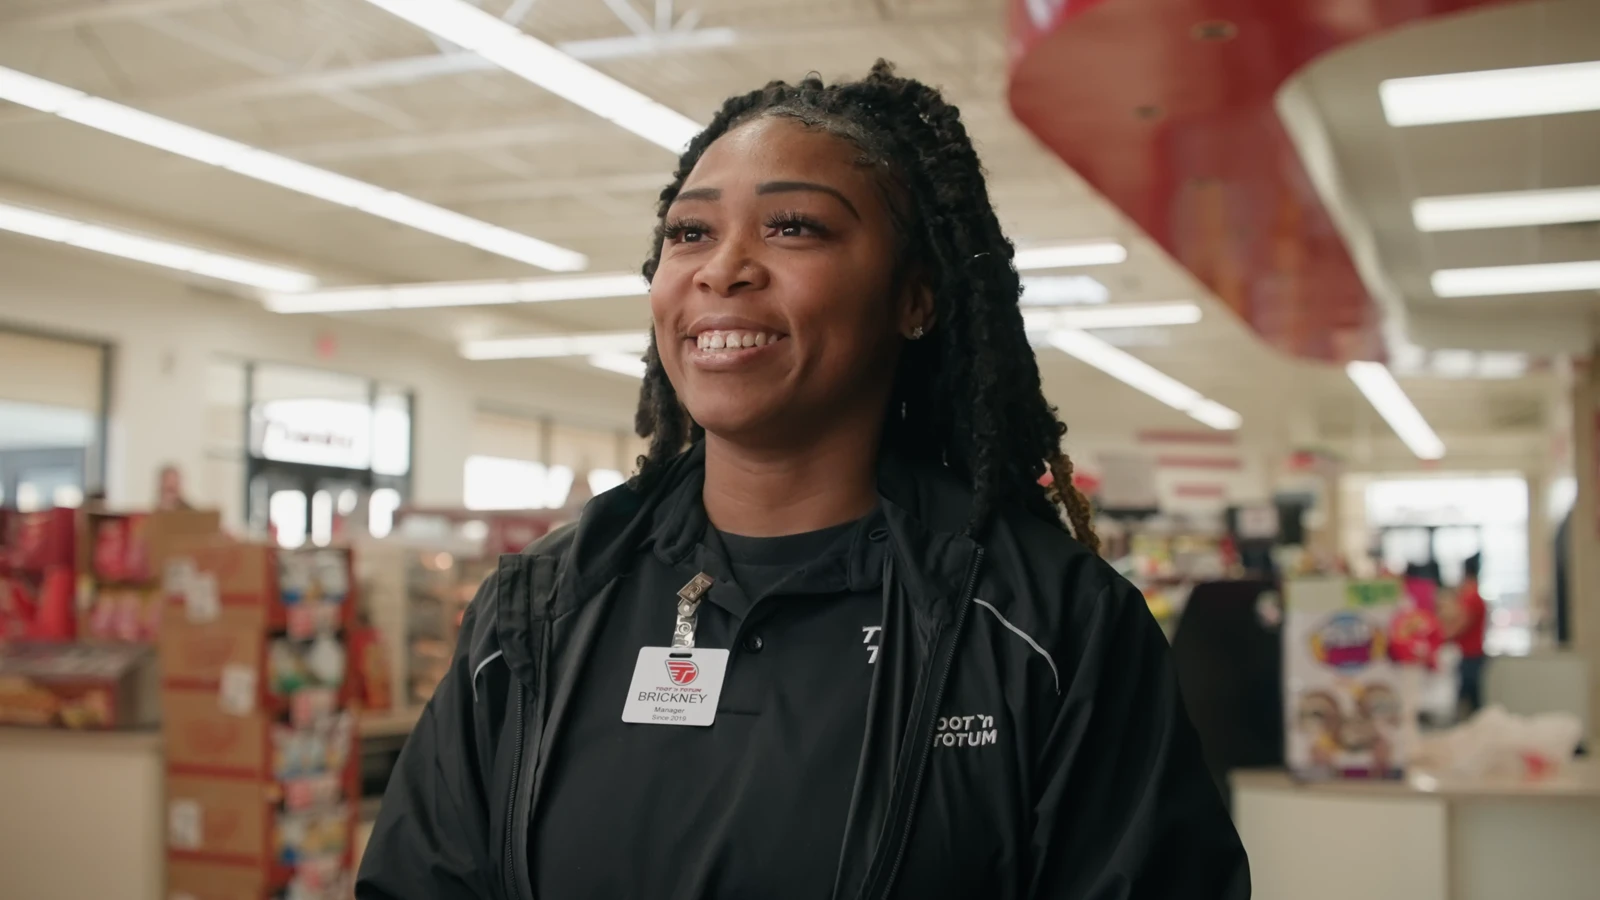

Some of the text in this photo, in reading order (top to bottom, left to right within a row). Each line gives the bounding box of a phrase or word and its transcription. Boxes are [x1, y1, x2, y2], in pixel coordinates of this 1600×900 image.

[638, 691, 707, 703] BRICKNEY
[654, 706, 685, 714] Manager
[937, 715, 975, 730] OOT
